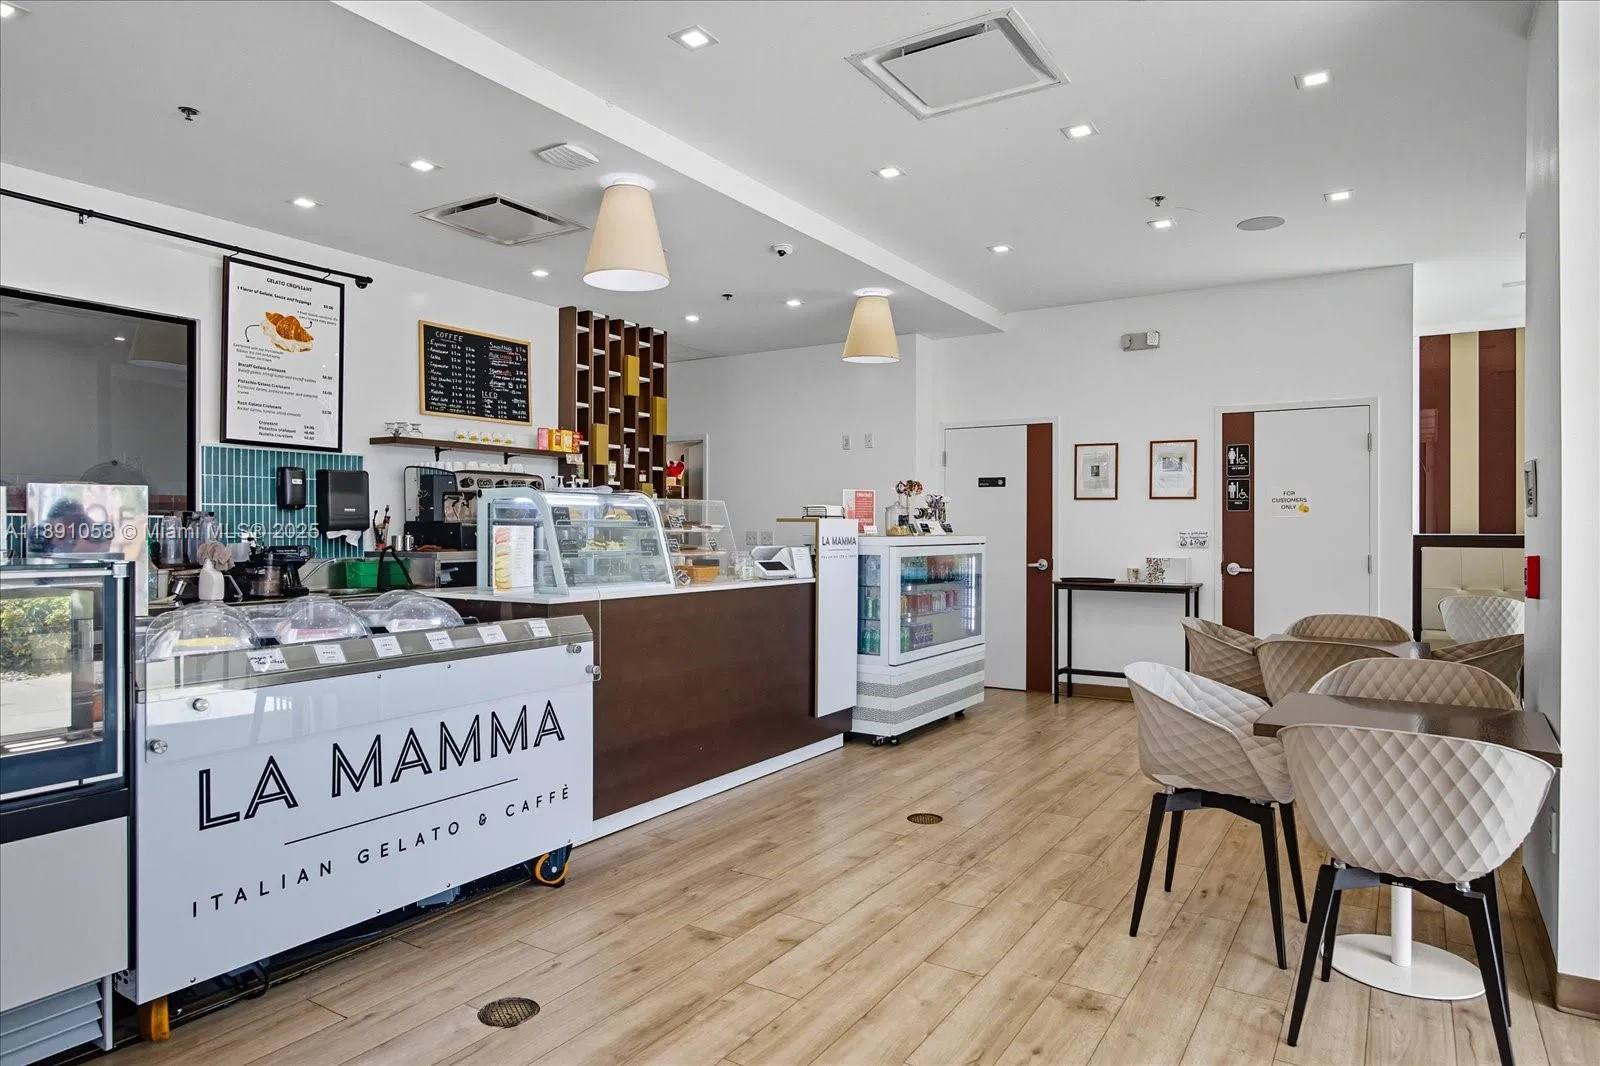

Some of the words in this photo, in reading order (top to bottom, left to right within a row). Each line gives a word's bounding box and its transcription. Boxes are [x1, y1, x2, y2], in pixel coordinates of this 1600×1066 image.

[266, 277, 285, 287] GELATO
[435, 330, 464, 342] COFFEE
[821, 535, 831, 546] LA
[831, 535, 857, 546] MAMMA
[199, 755, 298, 831] LA
[331, 699, 565, 798] MAMMA
[191, 859, 332, 918] ITALIAN
[357, 821, 460, 865] GELATO
[478, 813, 487, 826] &
[505, 784, 570, 817] CAFFÈ
